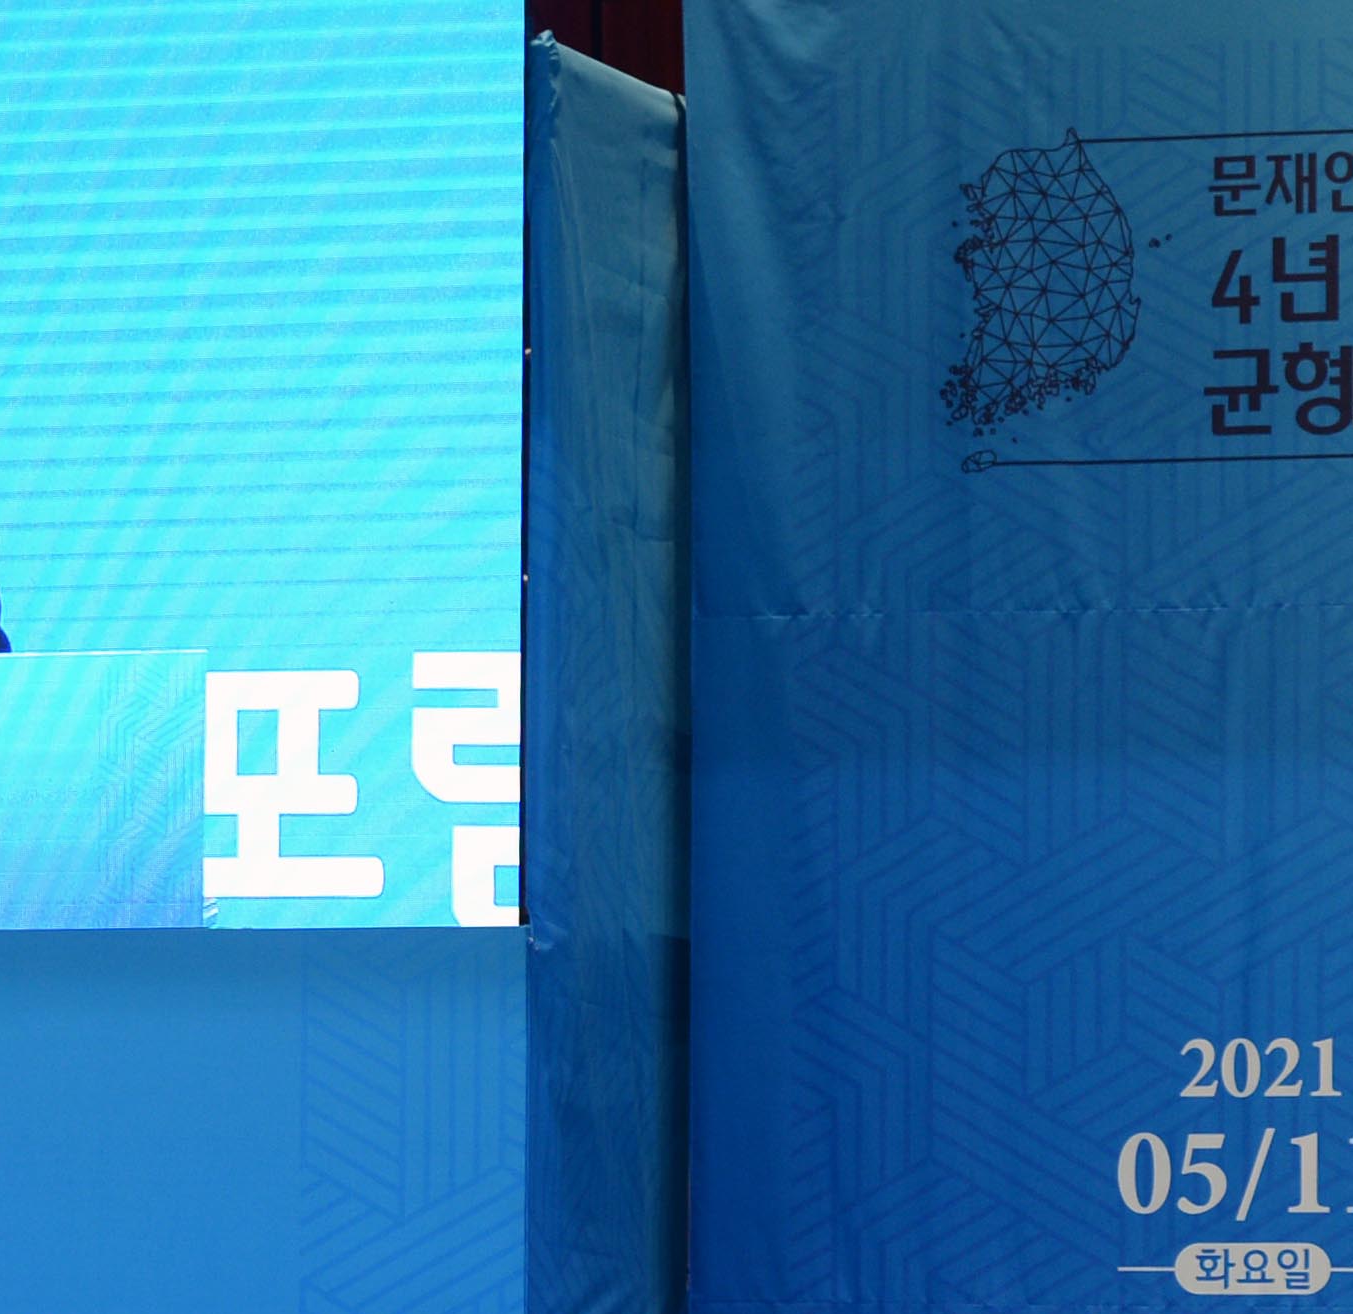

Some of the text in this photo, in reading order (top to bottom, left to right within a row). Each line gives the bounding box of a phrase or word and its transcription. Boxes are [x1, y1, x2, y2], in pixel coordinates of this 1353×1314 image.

[1204, 341, 1353, 436] 균형
[1179, 1037, 1342, 1098] 2021
[1117, 1127, 1353, 1222] 05/1
[1194, 1248, 1311, 1290] 화요일
